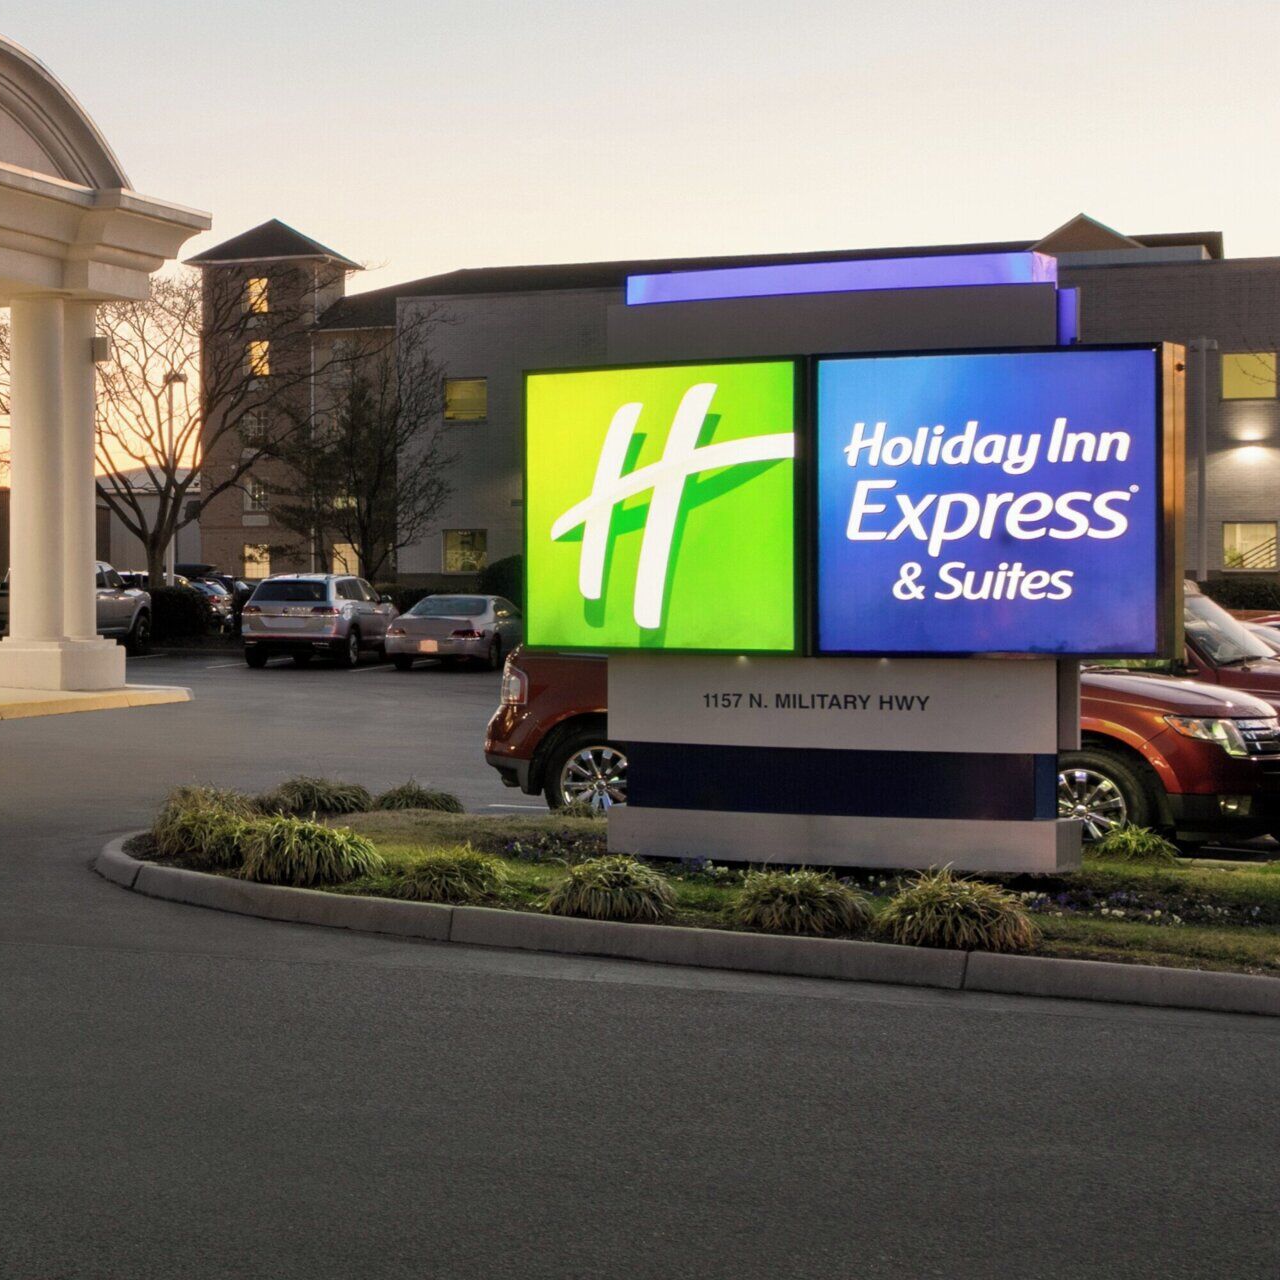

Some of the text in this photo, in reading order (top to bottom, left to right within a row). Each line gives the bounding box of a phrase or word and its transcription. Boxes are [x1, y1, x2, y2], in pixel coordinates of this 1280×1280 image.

[844, 417, 1130, 475] Holiday Inn
[892, 561, 1074, 600] & Suites
[702, 693, 930, 711] 1157 N. MILITARY HWY
